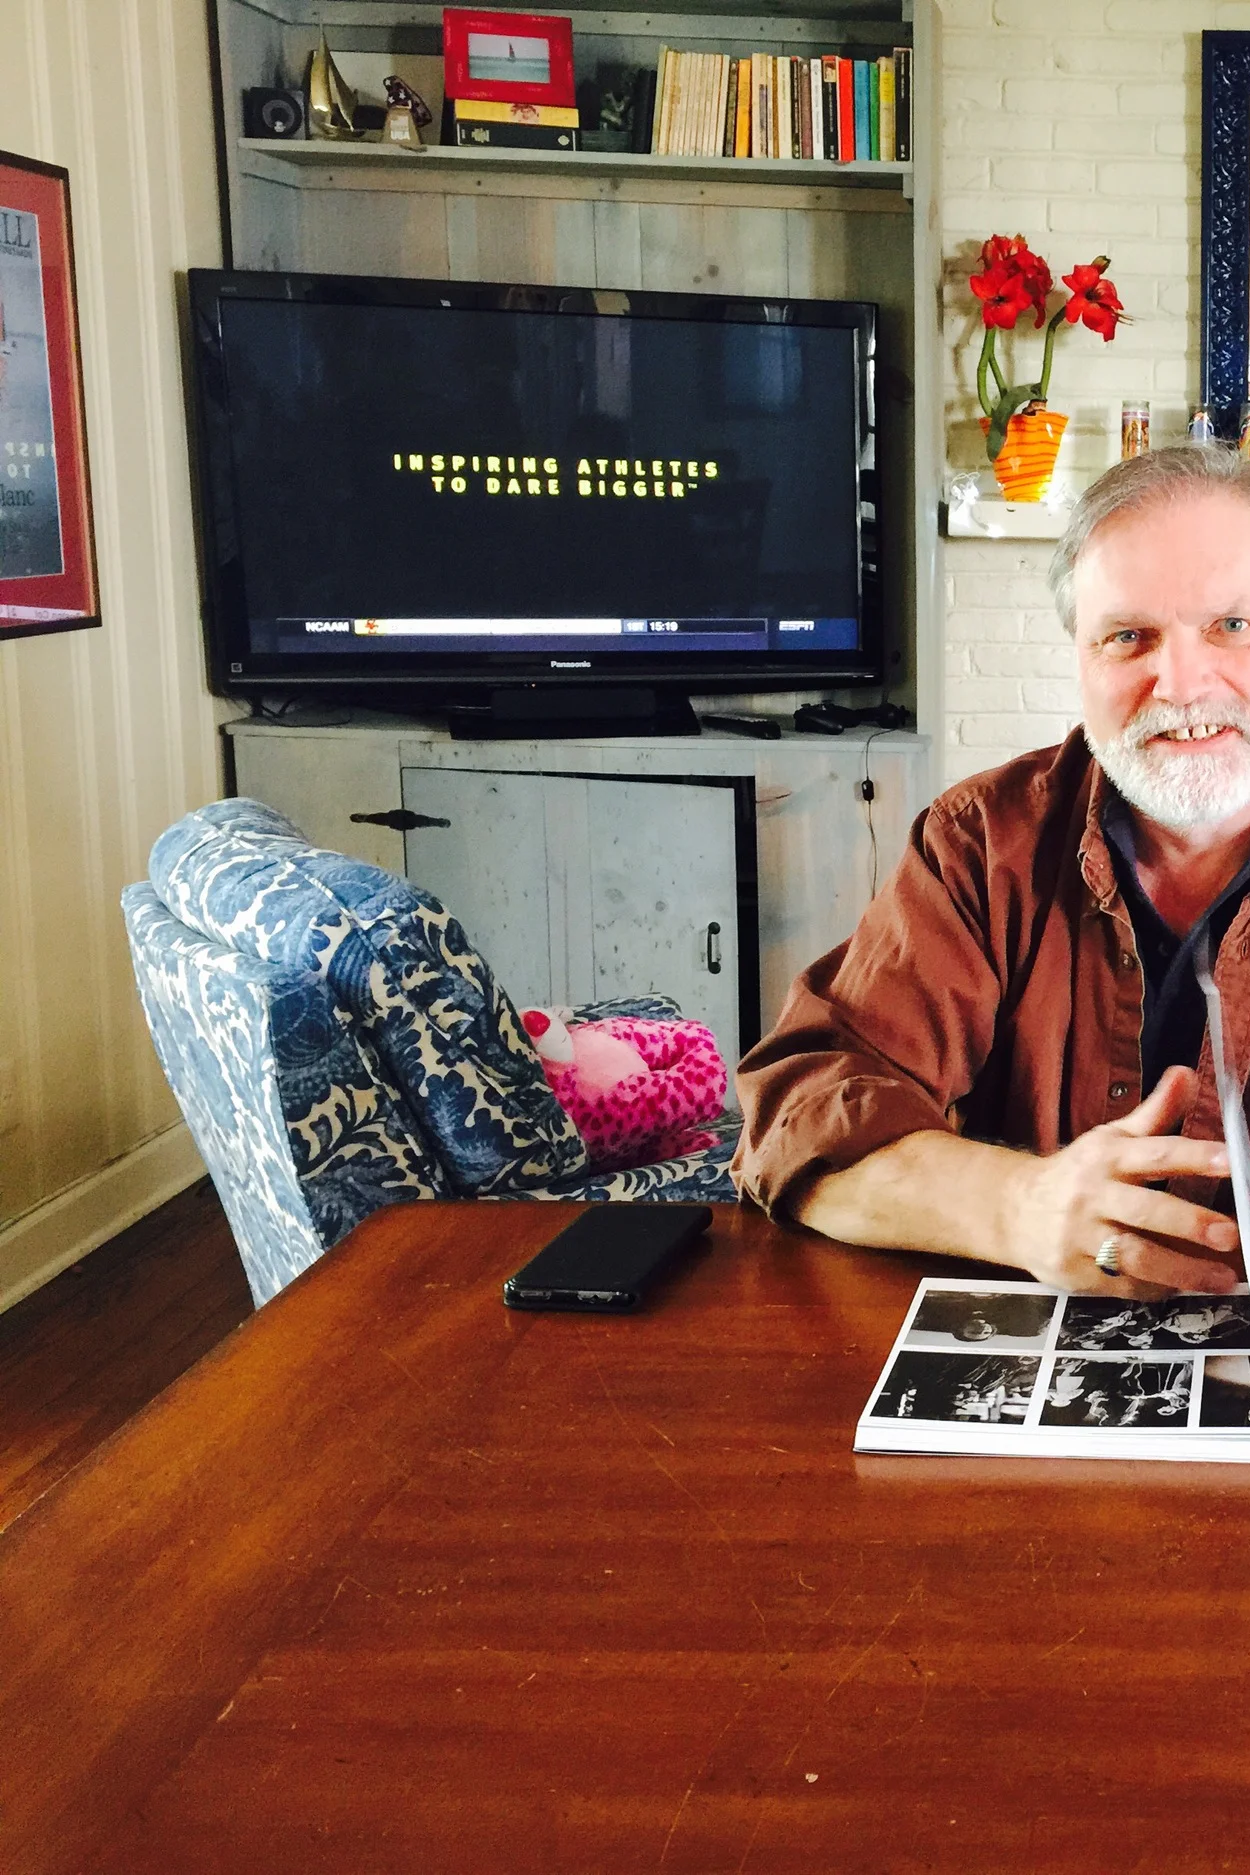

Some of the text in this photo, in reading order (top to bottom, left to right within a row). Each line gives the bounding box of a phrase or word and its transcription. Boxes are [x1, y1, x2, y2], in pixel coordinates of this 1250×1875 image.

[393, 453, 718, 478] INSPIRING ATHLETES
[431, 476, 467, 493] TO
[486, 477, 560, 495] DARE
[305, 621, 349, 633] NCAAM
[649, 621, 679, 632] 15:19
[779, 620, 815, 631] ESPN
[550, 660, 592, 668] Panasonic
